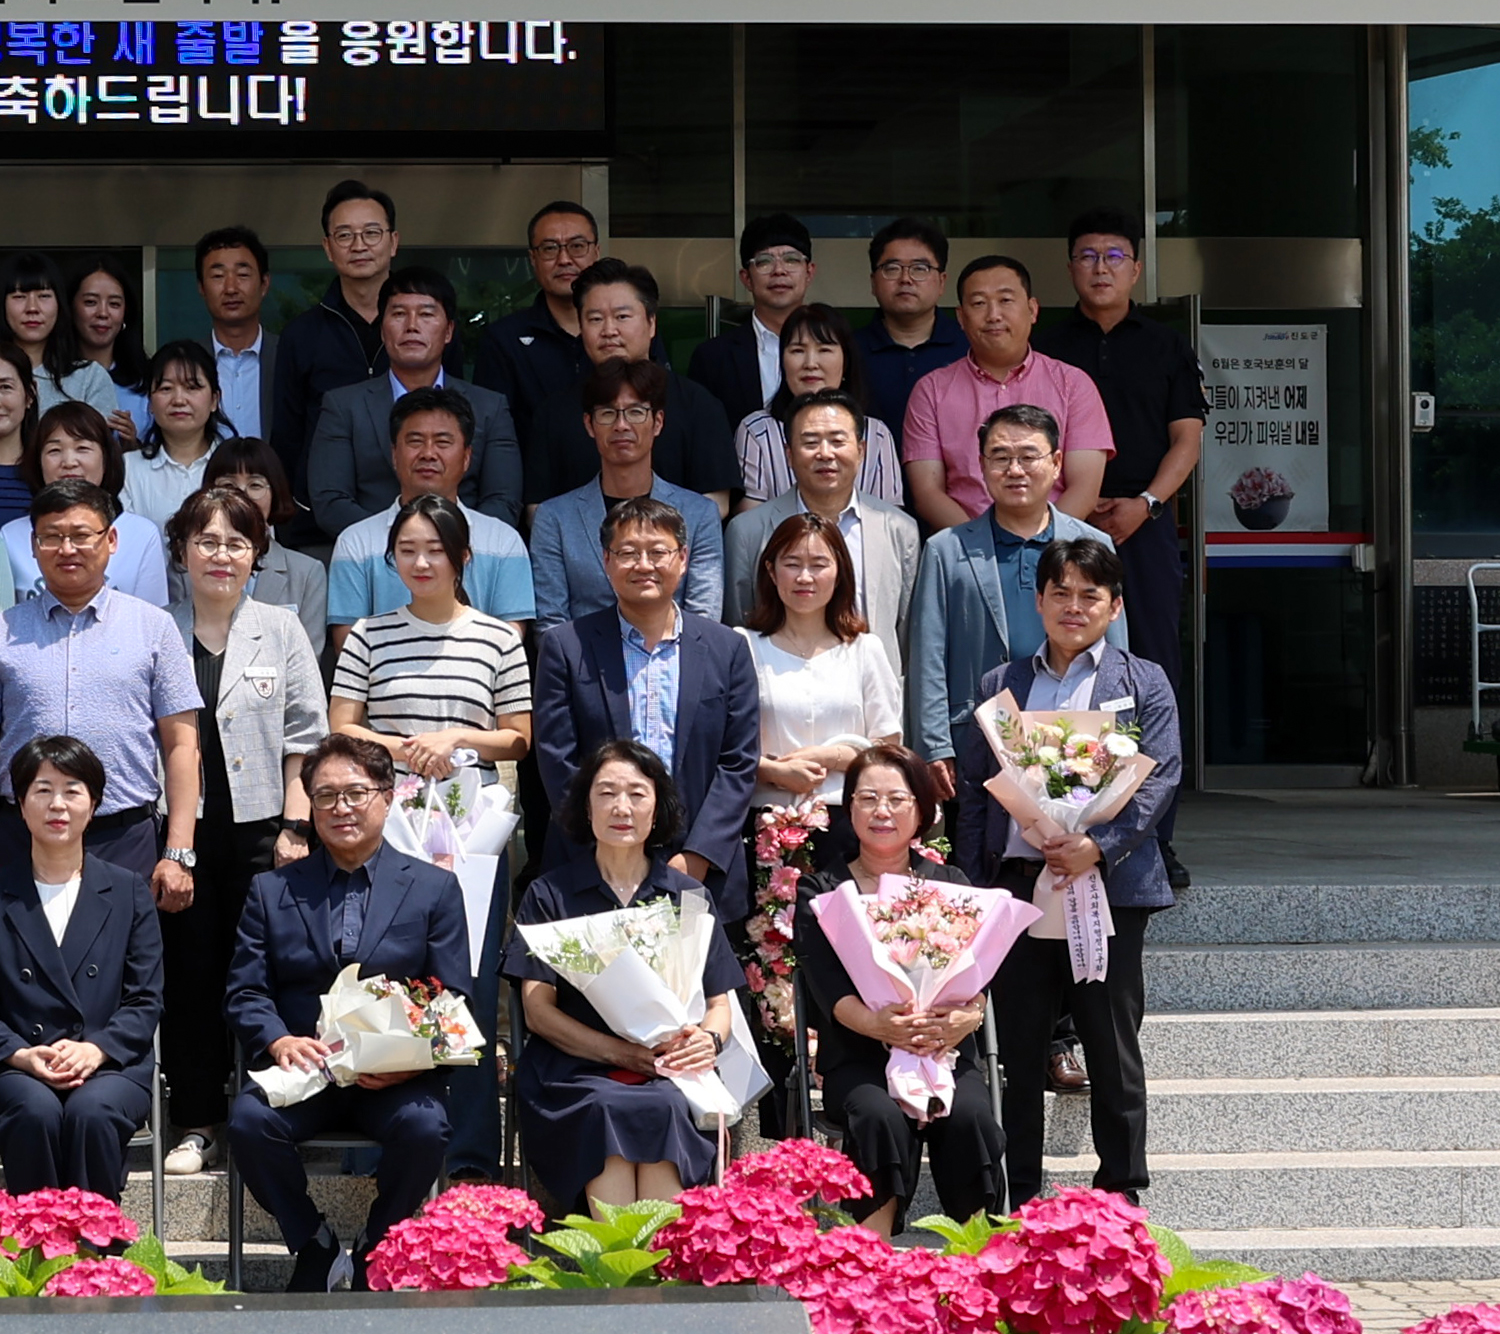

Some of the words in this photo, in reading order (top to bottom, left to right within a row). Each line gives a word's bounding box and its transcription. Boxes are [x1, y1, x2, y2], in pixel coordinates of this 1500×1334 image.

[113, 21, 155, 65] 새
[341, 21, 577, 67] 응원합니다.
[1212, 357, 1240, 370] 6월은
[1242, 357, 1296, 370] 호국보훈의
[1298, 357, 1309, 370] 달
[1244, 385, 1280, 410] 지켜낸
[1284, 385, 1308, 410] 어제
[1215, 421, 1253, 446] 우리가
[1256, 421, 1292, 446] 피워낼
[1295, 420, 1320, 446] 내일
